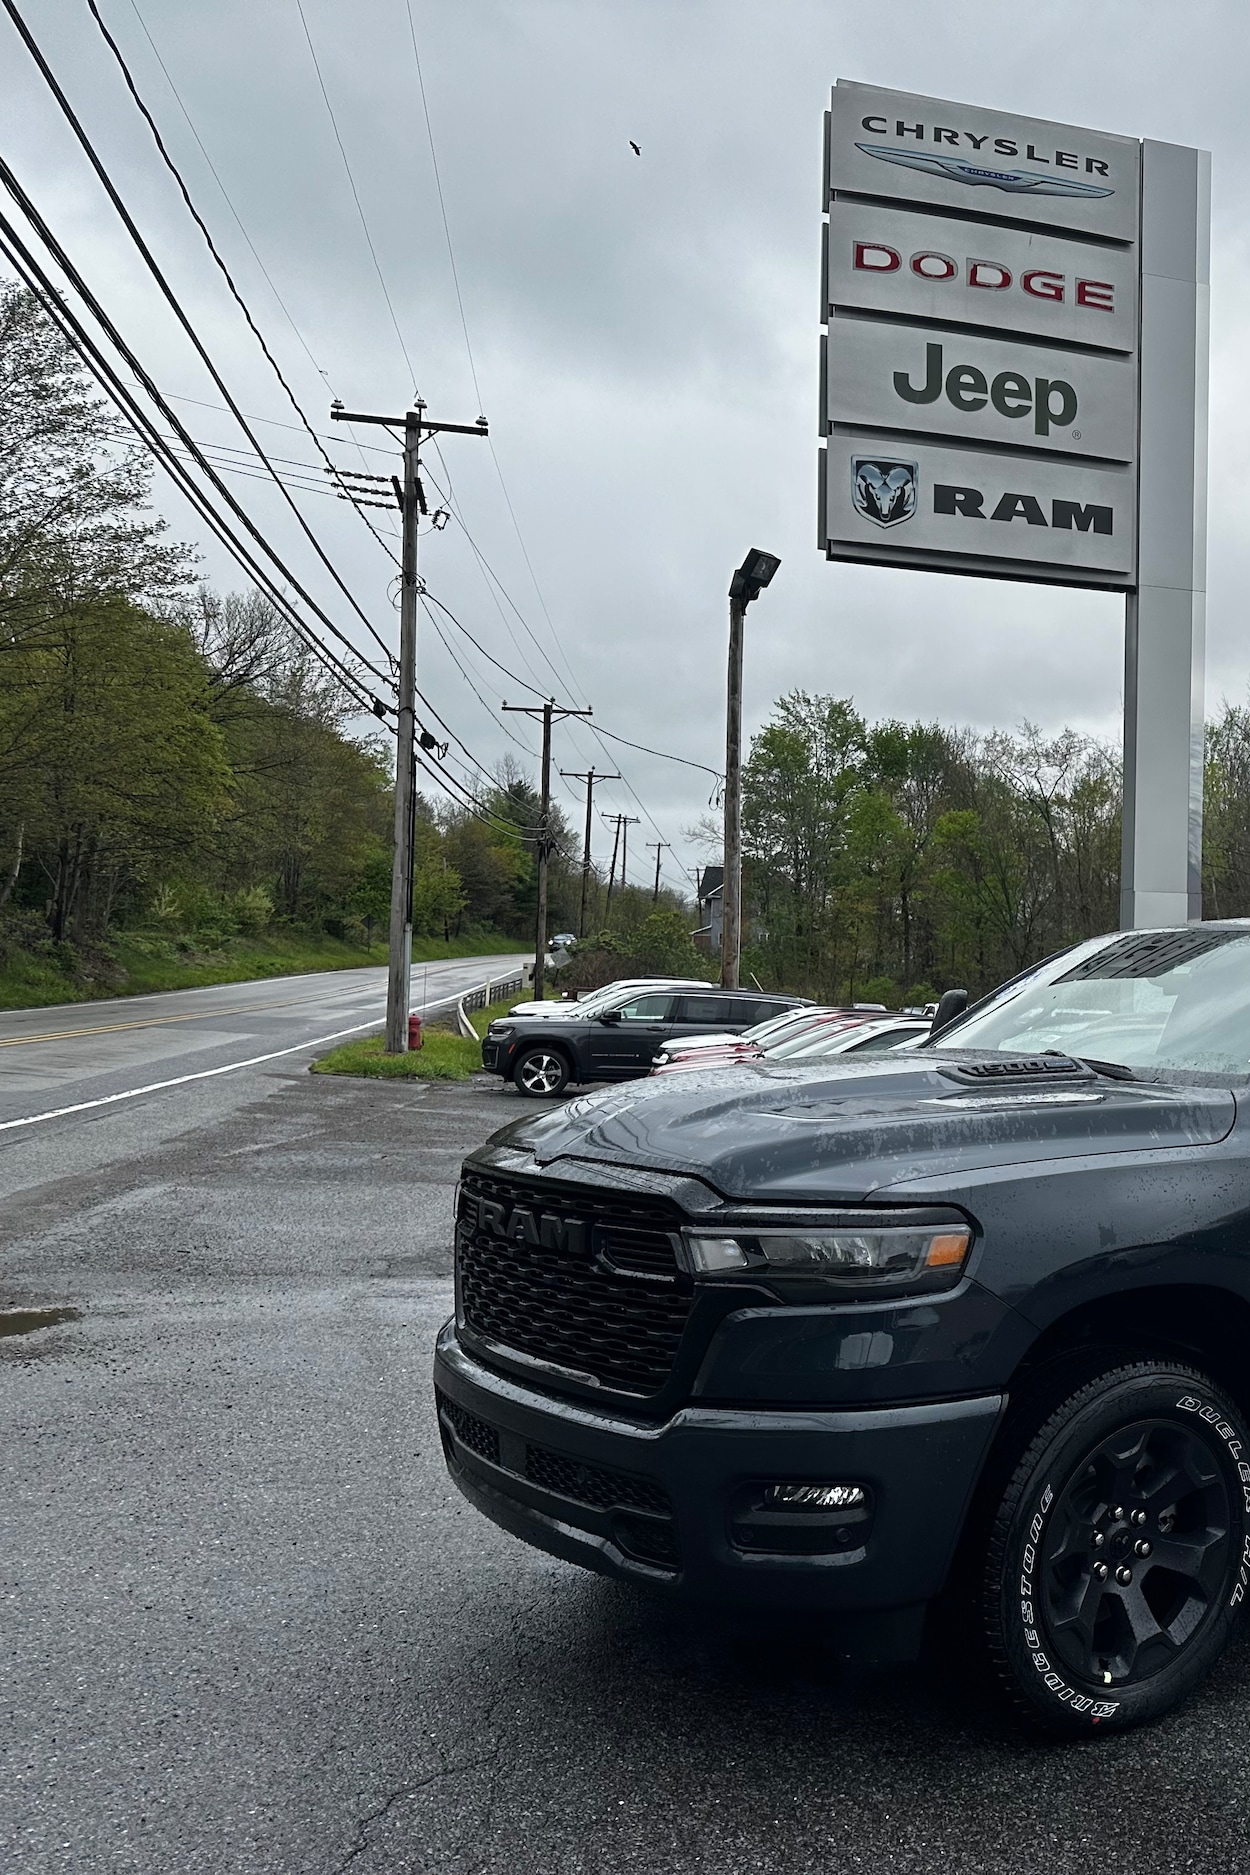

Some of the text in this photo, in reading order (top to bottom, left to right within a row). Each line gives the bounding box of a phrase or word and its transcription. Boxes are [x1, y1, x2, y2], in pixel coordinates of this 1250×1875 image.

[861, 115, 1110, 177] CHRYSLER
[963, 167, 1015, 181] CHRYSLER
[853, 240, 1115, 313] DODGE
[893, 342, 1078, 436] Jeep
[933, 483, 1113, 536] RAM
[965, 1061, 1046, 1077] 1500
[479, 1199, 586, 1254] RAM
[1021, 1483, 1120, 1718] BRIDGESTONE
